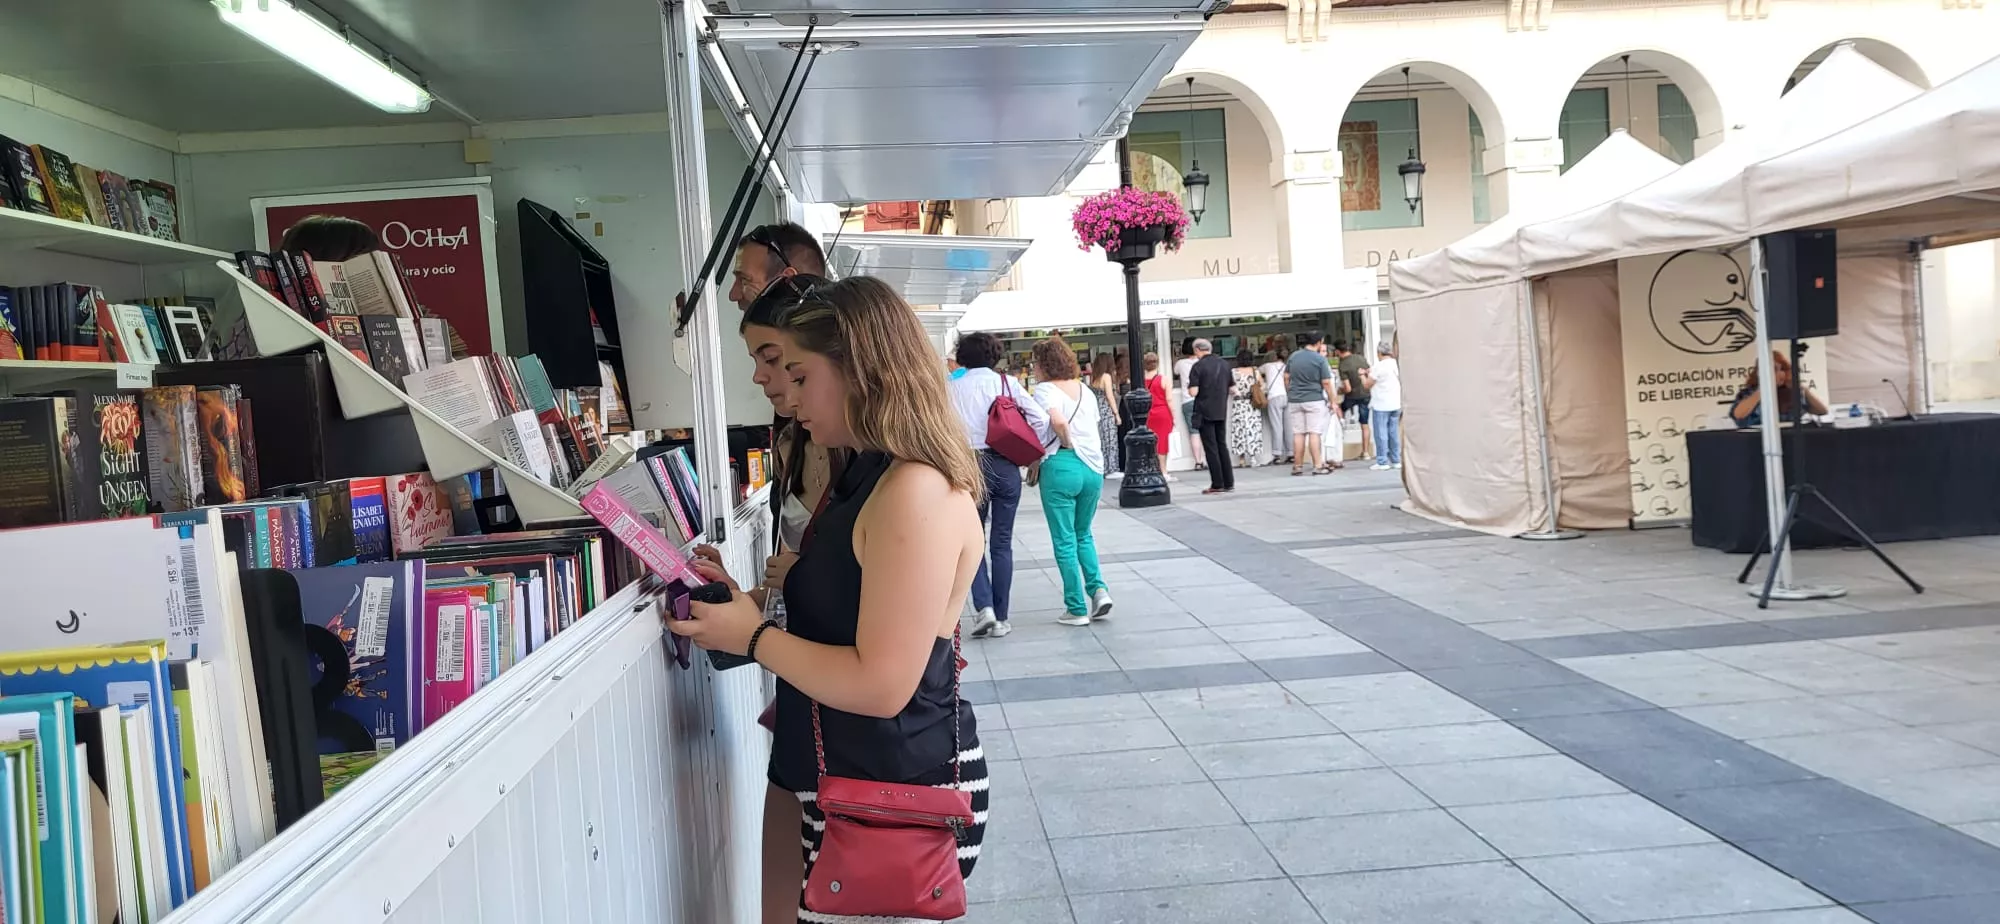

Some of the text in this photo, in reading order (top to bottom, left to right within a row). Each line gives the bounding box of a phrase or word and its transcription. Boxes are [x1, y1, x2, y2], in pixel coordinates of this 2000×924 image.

[382, 221, 469, 250] OCHOA
[423, 267, 429, 278] y
[432, 264, 455, 274] ocio
[1637, 367, 1725, 385] ASOCIACIÓN
[93, 393, 116, 406] ALEXIS
[1638, 390, 1657, 402] DE
[1661, 384, 1735, 401] LIBRERIAS
[506, 427, 520, 453] JULIA
[99, 476, 152, 506] UNSEEN
[353, 515, 385, 530] ENAVENT
